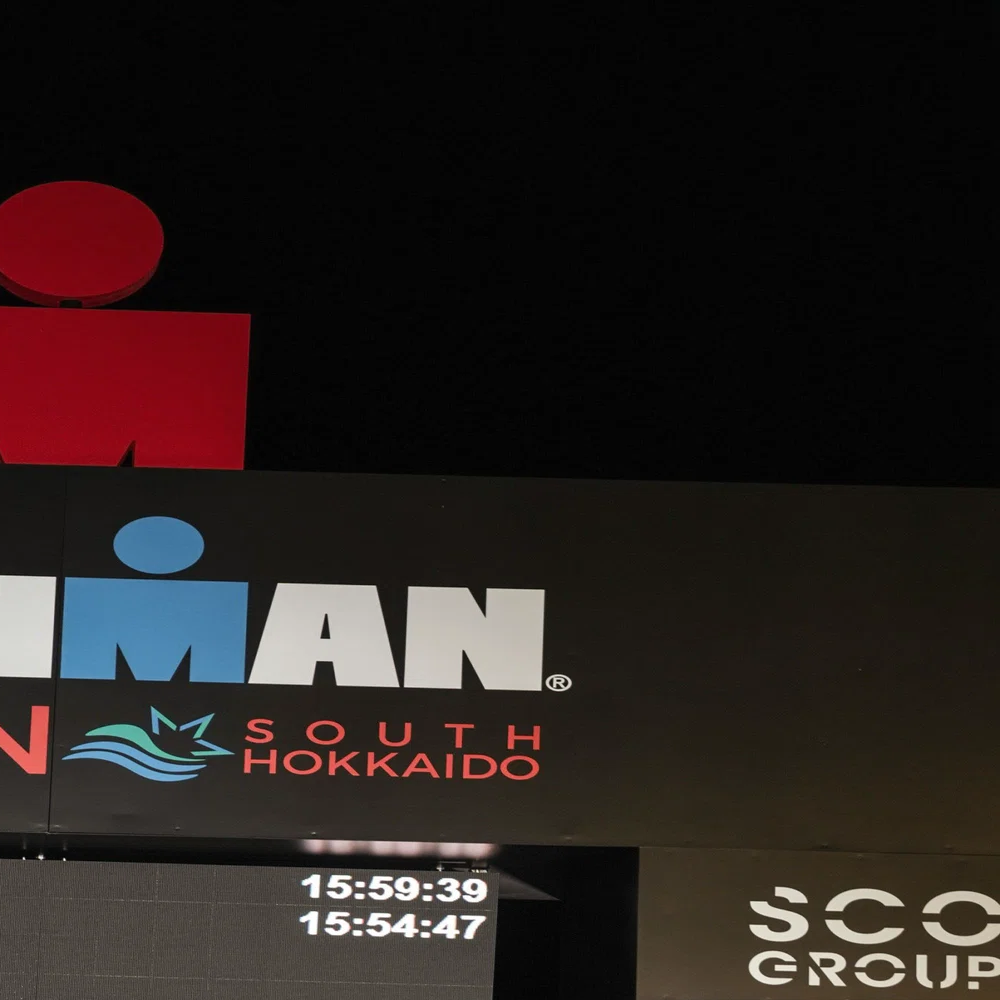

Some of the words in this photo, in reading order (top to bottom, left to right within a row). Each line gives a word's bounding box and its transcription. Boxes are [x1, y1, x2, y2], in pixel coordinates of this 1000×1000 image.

[244, 718, 541, 750] SOUTH
[243, 748, 541, 780] HOKKAIDO
[301, 874, 488, 903] 15:59:39
[299, 911, 487, 940] 15:54:47
[749, 886, 1000, 947] SCO
[748, 950, 1000, 990] GROUP
